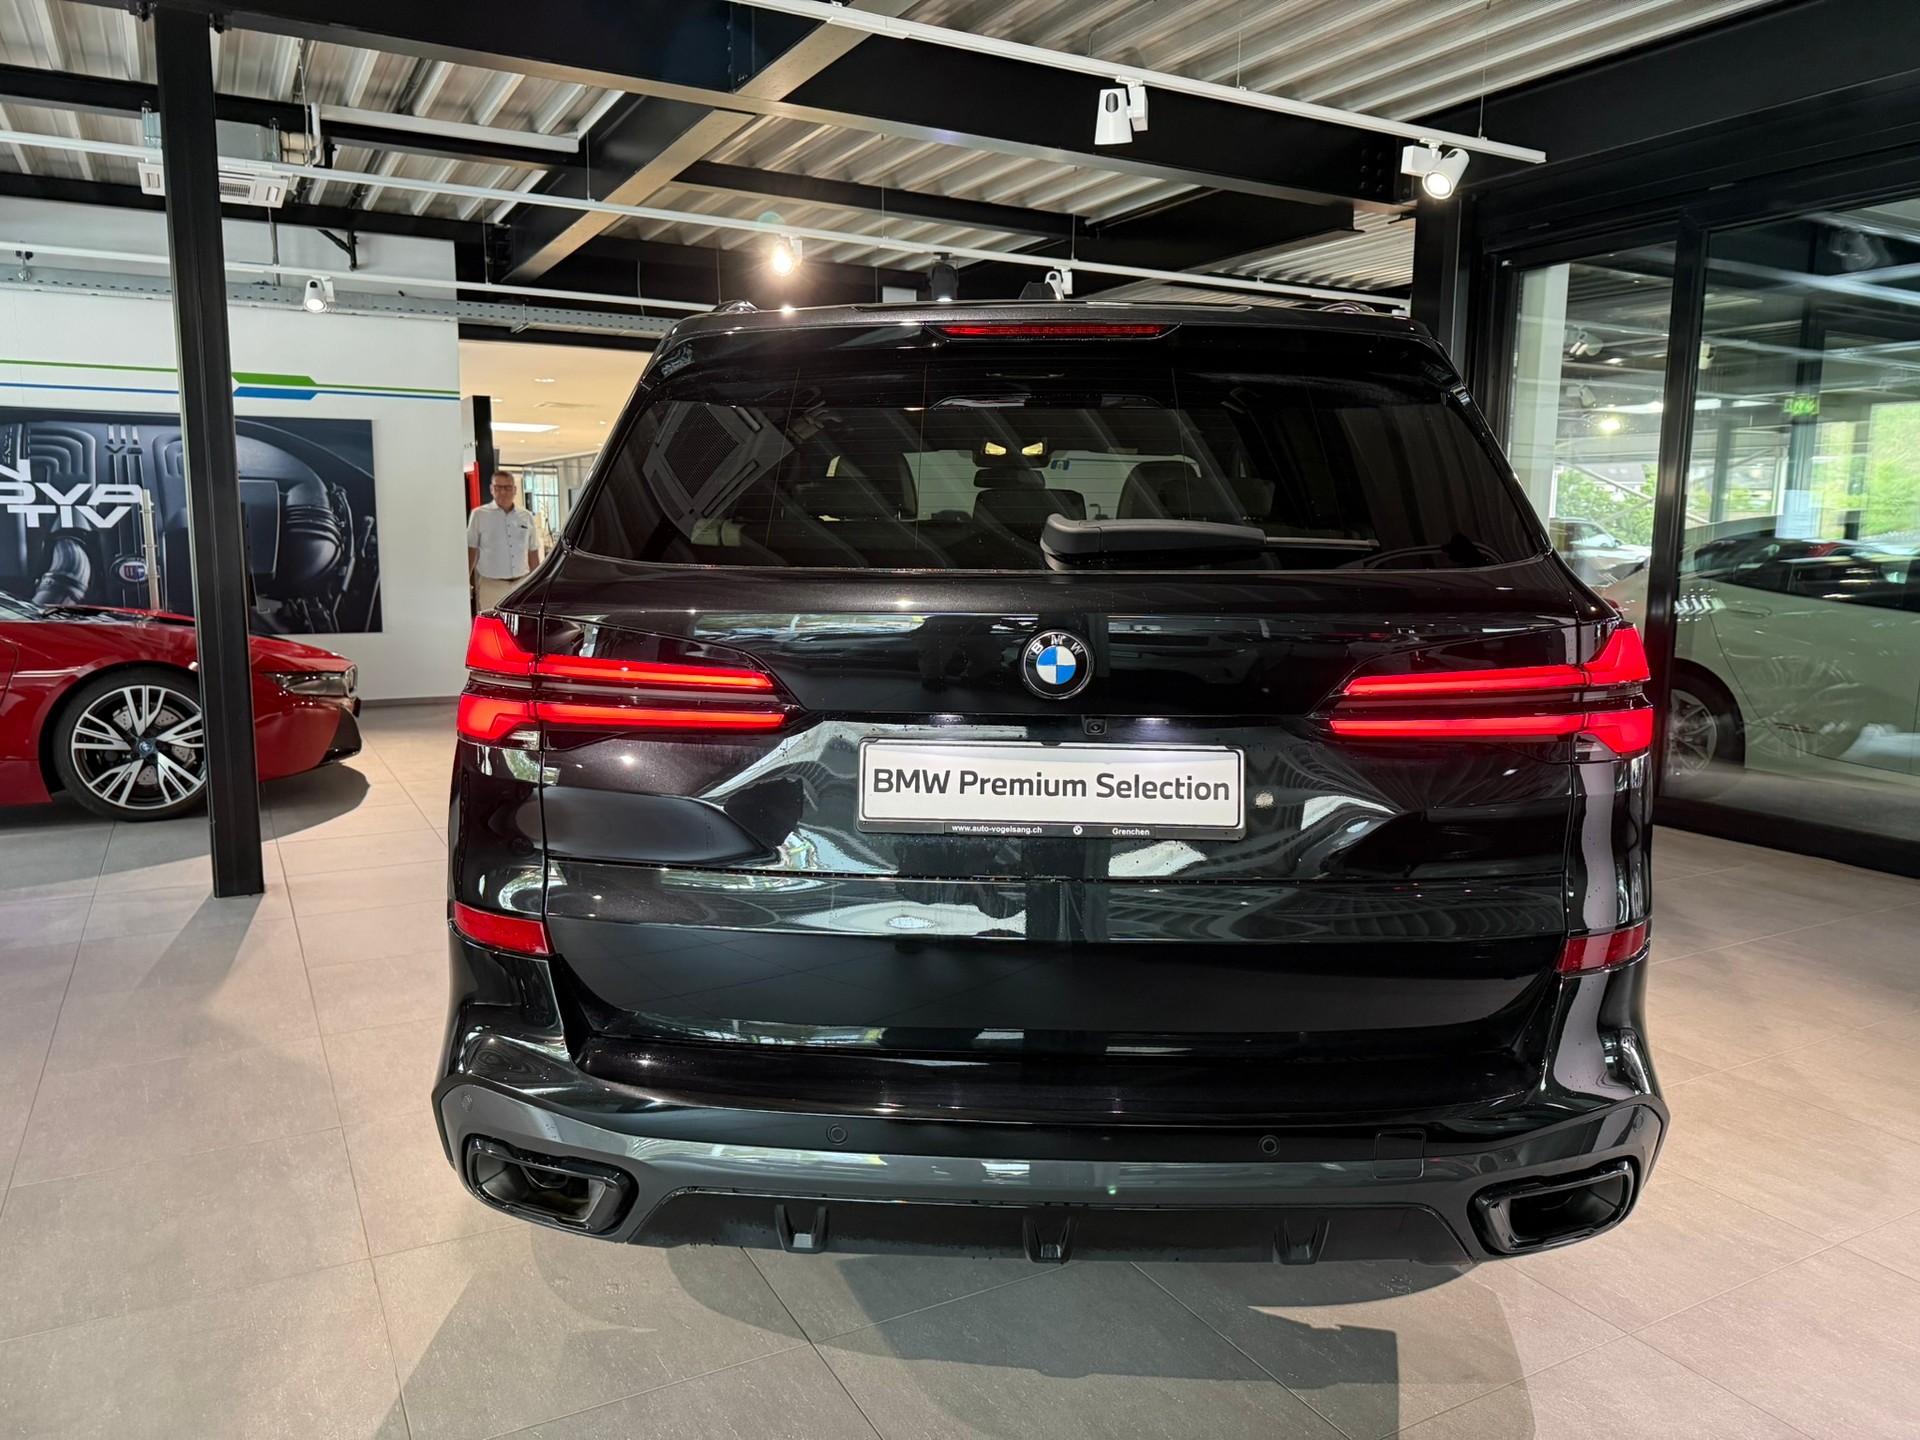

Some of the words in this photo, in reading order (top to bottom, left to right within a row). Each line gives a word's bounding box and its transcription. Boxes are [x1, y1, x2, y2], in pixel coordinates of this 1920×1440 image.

[7, 505, 132, 528] TIV
[1031, 634, 1084, 655] BMW
[874, 768, 951, 794] BMW
[959, 770, 1087, 797] Premium
[1096, 772, 1230, 801] Selection
[951, 825, 1043, 835] www.auto-vogelsang.ch
[1111, 827, 1151, 837] Grenchen
